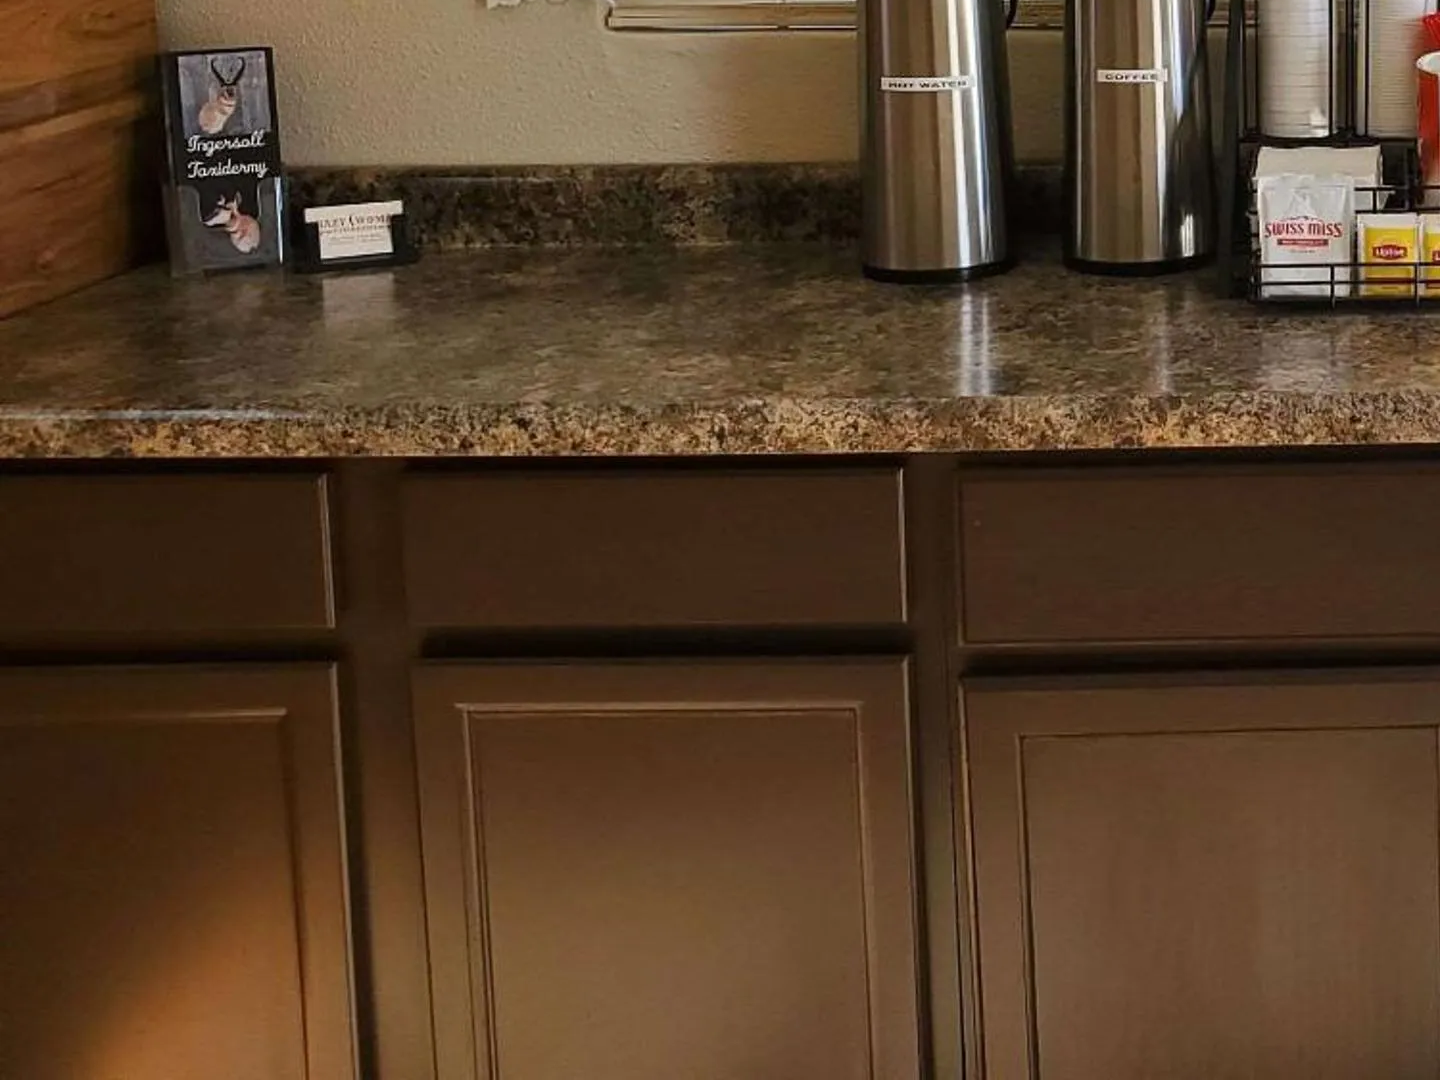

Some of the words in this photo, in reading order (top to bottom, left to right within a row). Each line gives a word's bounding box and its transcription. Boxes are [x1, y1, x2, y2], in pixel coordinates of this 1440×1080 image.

[919, 80, 967, 88] WATER
[187, 128, 266, 158] Ingersoll
[187, 158, 269, 178] Taxidermy
[1264, 222, 1305, 238] SWISS
[1375, 246, 1405, 258] Lipton
